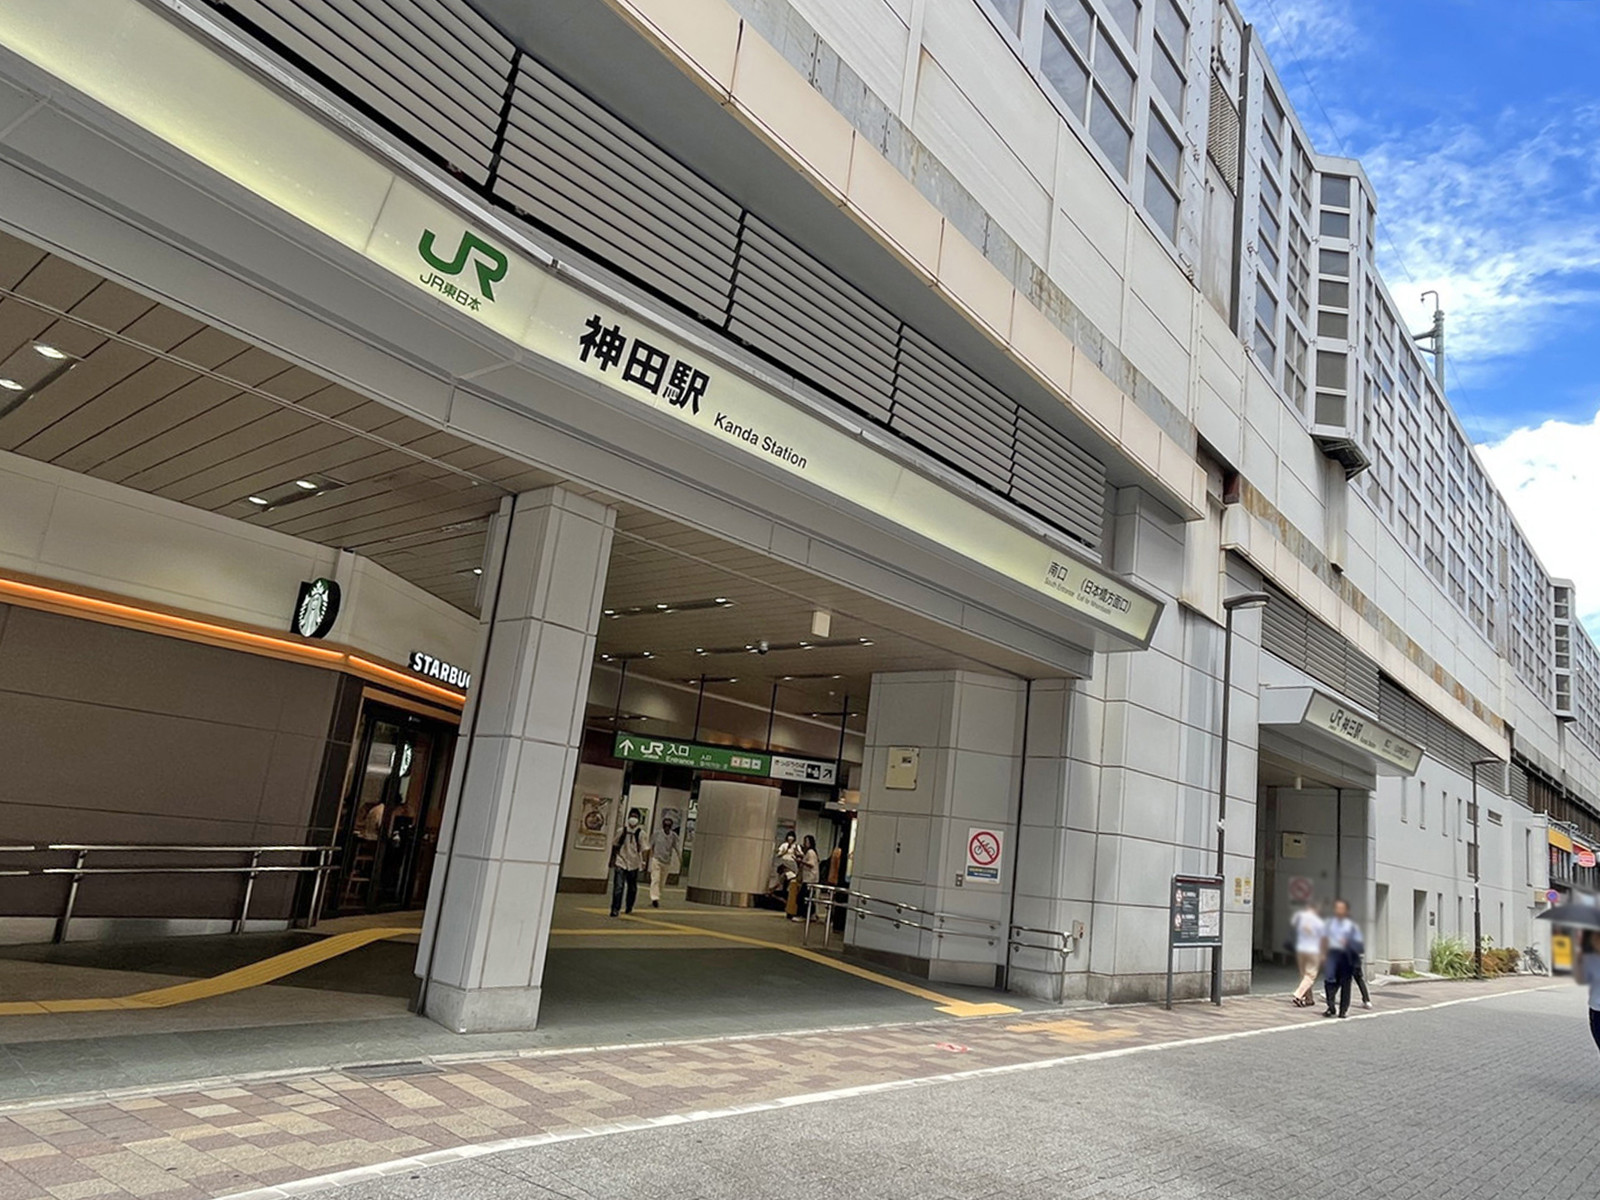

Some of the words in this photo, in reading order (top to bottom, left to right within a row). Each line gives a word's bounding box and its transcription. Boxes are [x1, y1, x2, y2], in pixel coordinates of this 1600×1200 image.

[418, 229, 508, 302] JR
[419, 273, 483, 312] JR東日本
[578, 314, 711, 416] 神田駅
[713, 411, 760, 446] Kanda
[761, 435, 808, 470] Station
[1048, 562, 1068, 581] 南口
[1329, 709, 1345, 727] JR
[640, 742, 663, 757] JR
[666, 743, 690, 757] 入口
[665, 755, 695, 766] Entrance
